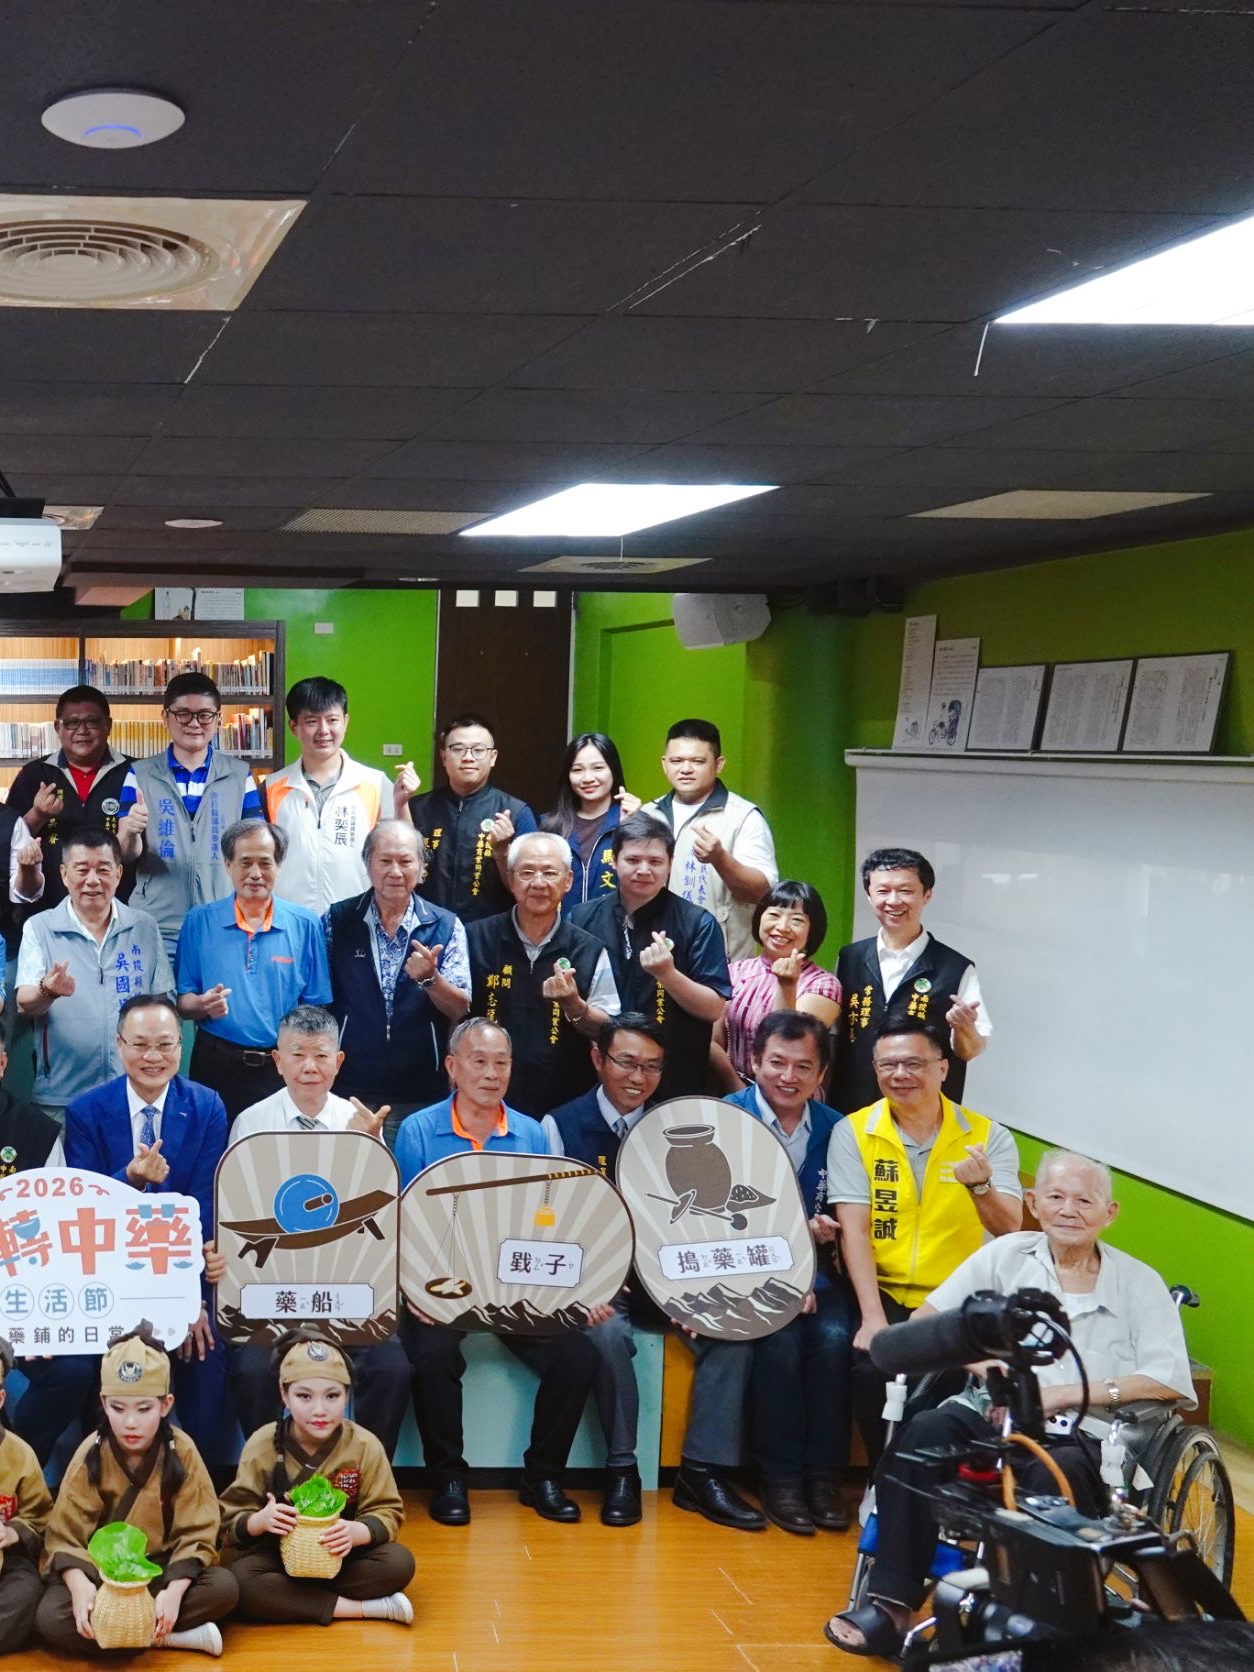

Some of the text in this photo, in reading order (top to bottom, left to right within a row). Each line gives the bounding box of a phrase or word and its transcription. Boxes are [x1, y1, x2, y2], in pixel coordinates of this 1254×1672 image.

[334, 805, 349, 846] 林奕辰
[16, 1177, 85, 1198] 2026
[873, 1158, 899, 1241] 蘇昱誠
[676, 1244, 772, 1273] 搗藥罐
[4, 1287, 108, 1315] 生活節
[275, 1290, 333, 1313] 藥船
